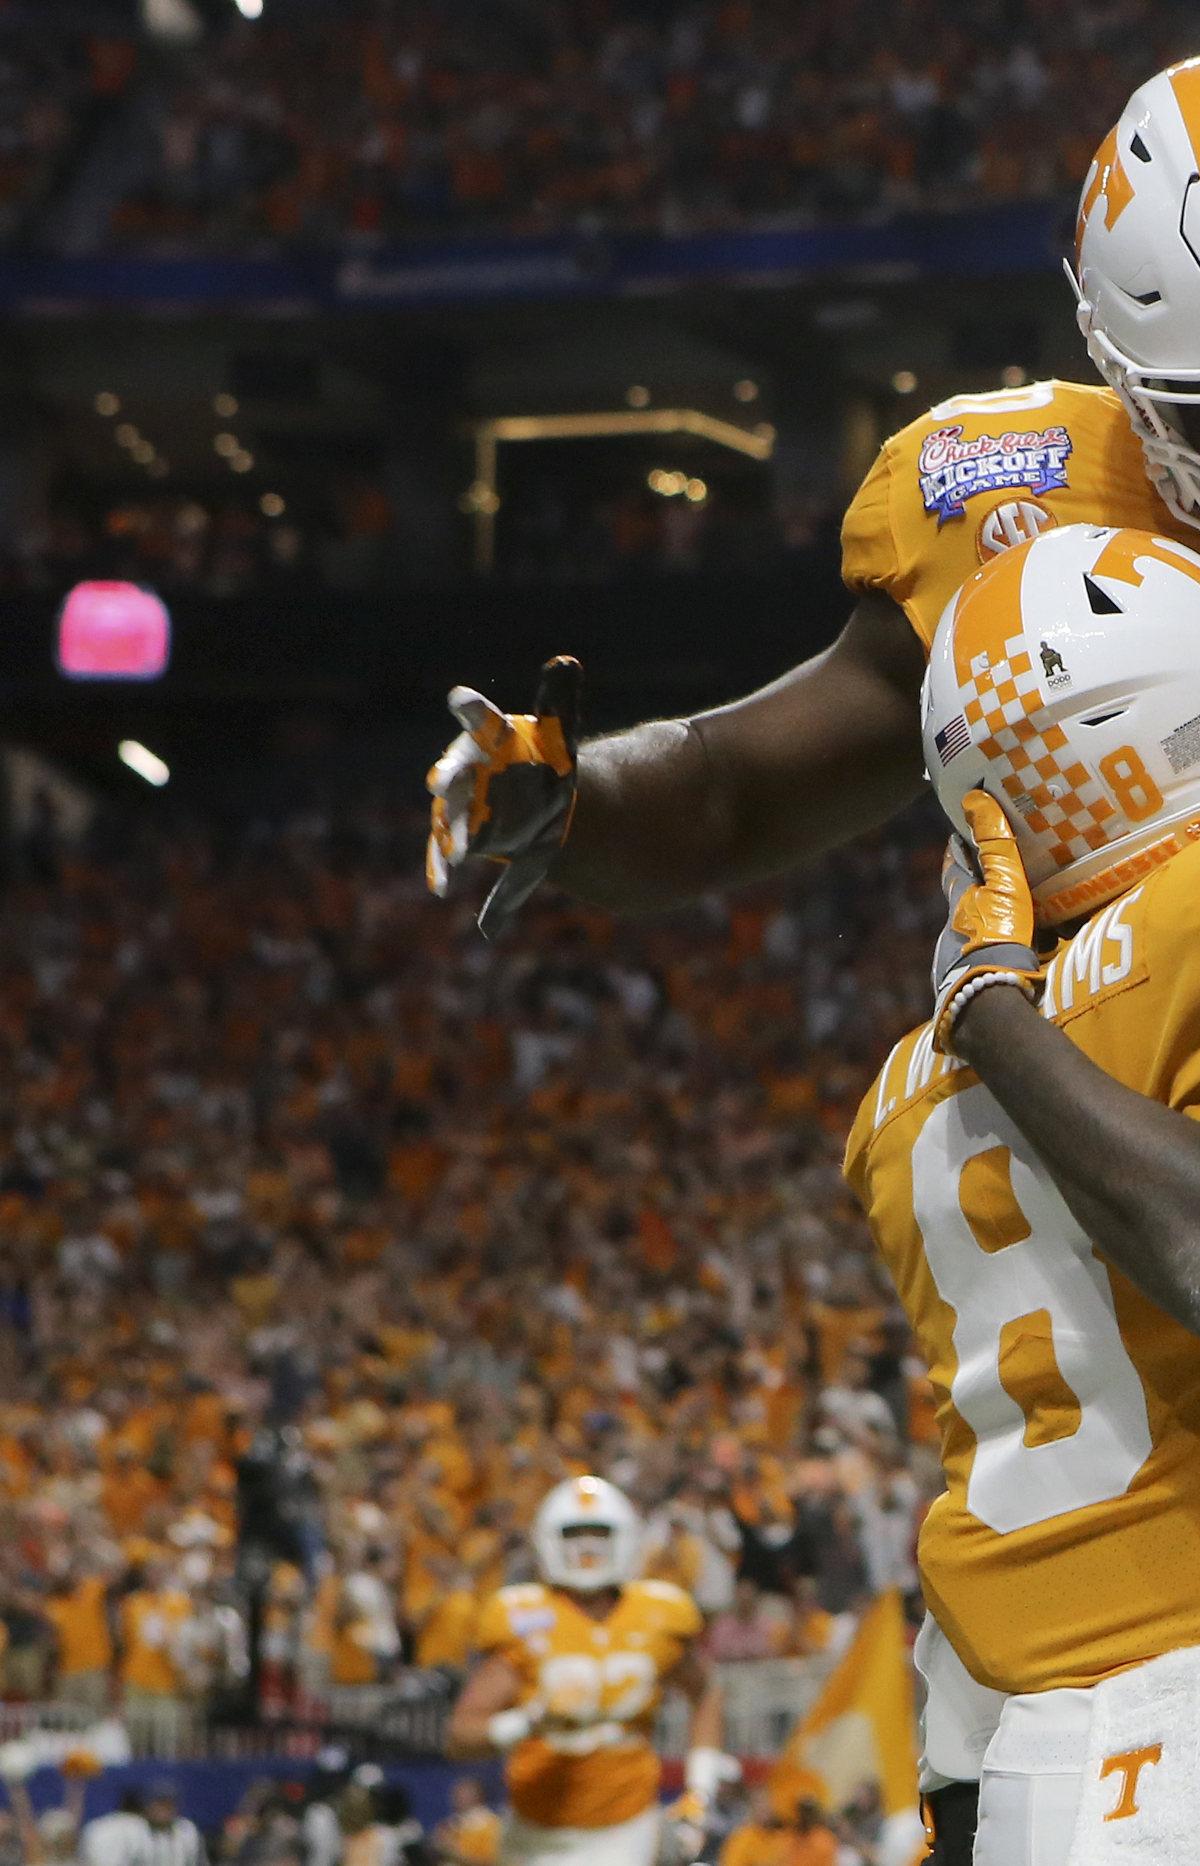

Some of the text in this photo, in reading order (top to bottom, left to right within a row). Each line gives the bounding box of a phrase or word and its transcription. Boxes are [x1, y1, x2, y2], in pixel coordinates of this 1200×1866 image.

[920, 447, 1069, 507] KICKOFF
[949, 471, 1042, 503] GAME
[1099, 745, 1164, 823] 8
[912, 1082, 1153, 1535] 8
[1098, 1744, 1162, 1822] T
